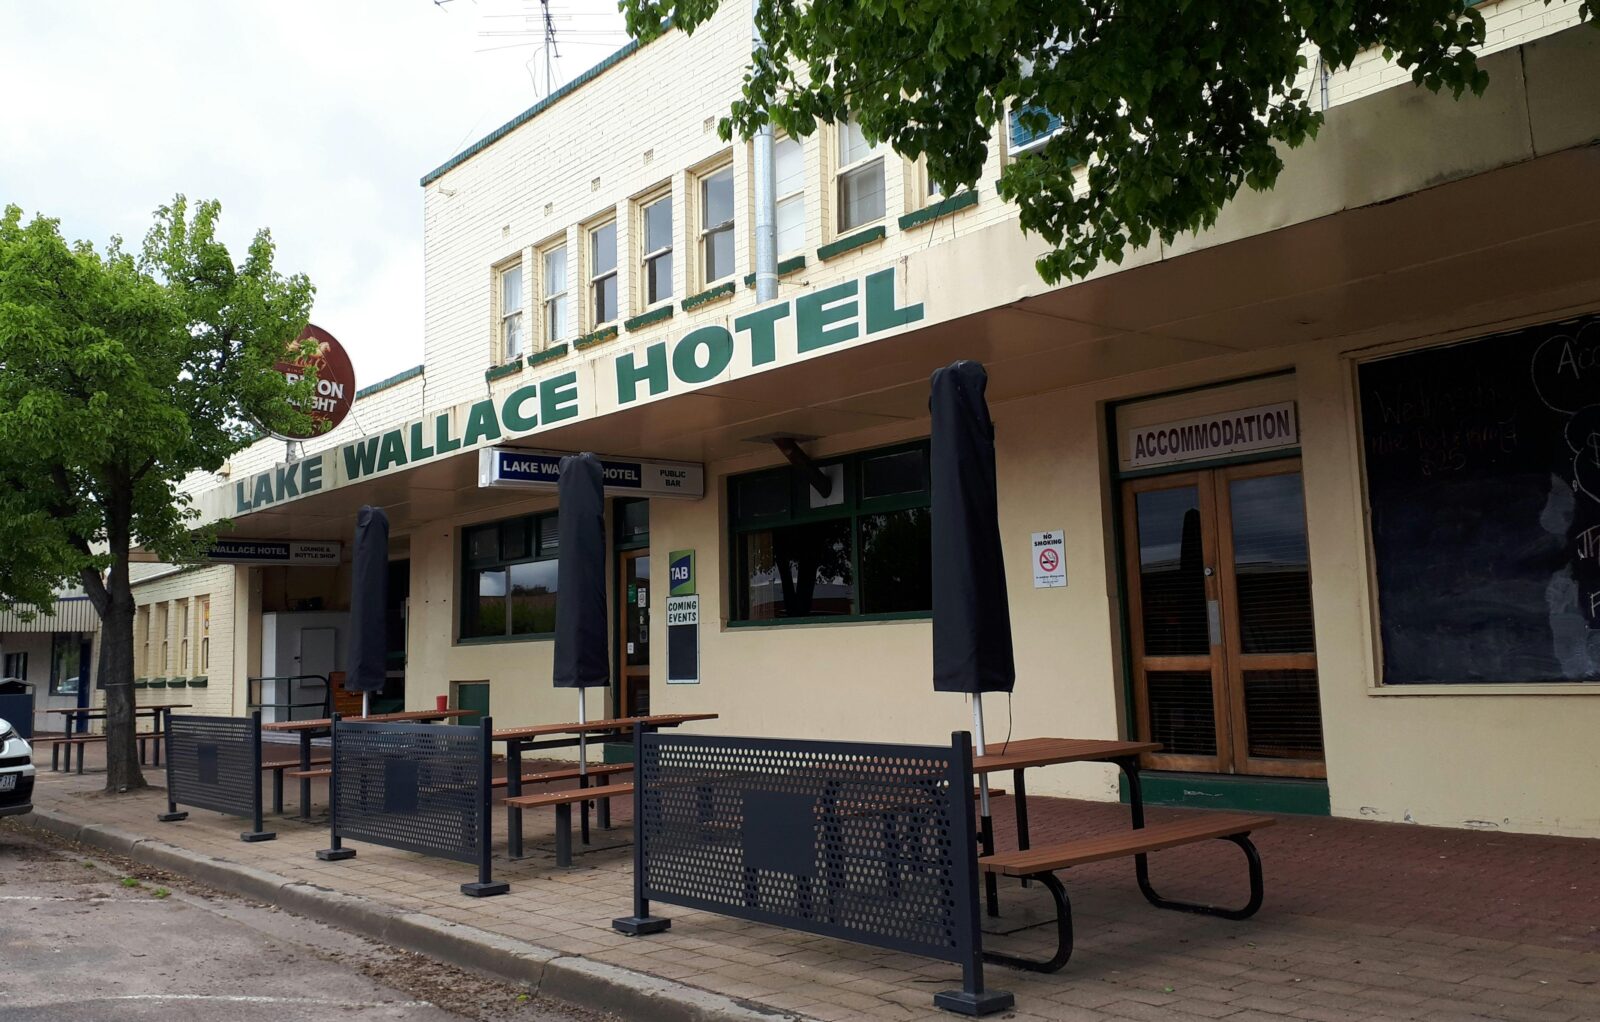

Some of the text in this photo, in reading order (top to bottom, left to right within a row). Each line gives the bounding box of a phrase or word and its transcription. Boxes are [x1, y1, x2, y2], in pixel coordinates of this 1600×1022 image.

[236, 267, 924, 513] LAKE WALLACE HOTEL
[1135, 409, 1290, 459] ACCOMMODATION
[503, 460, 538, 473] LAKE
[602, 467, 638, 480] HOTEL
[660, 469, 686, 478] PUBLIC
[665, 478, 681, 487] BAR
[1034, 539, 1062, 547] SMOKING
[211, 544, 256, 554] WALLACE
[257, 547, 287, 555] HOTEL
[671, 566, 688, 580] TAB
[668, 601, 697, 611] COMING
[668, 612, 697, 623] EVENTS
